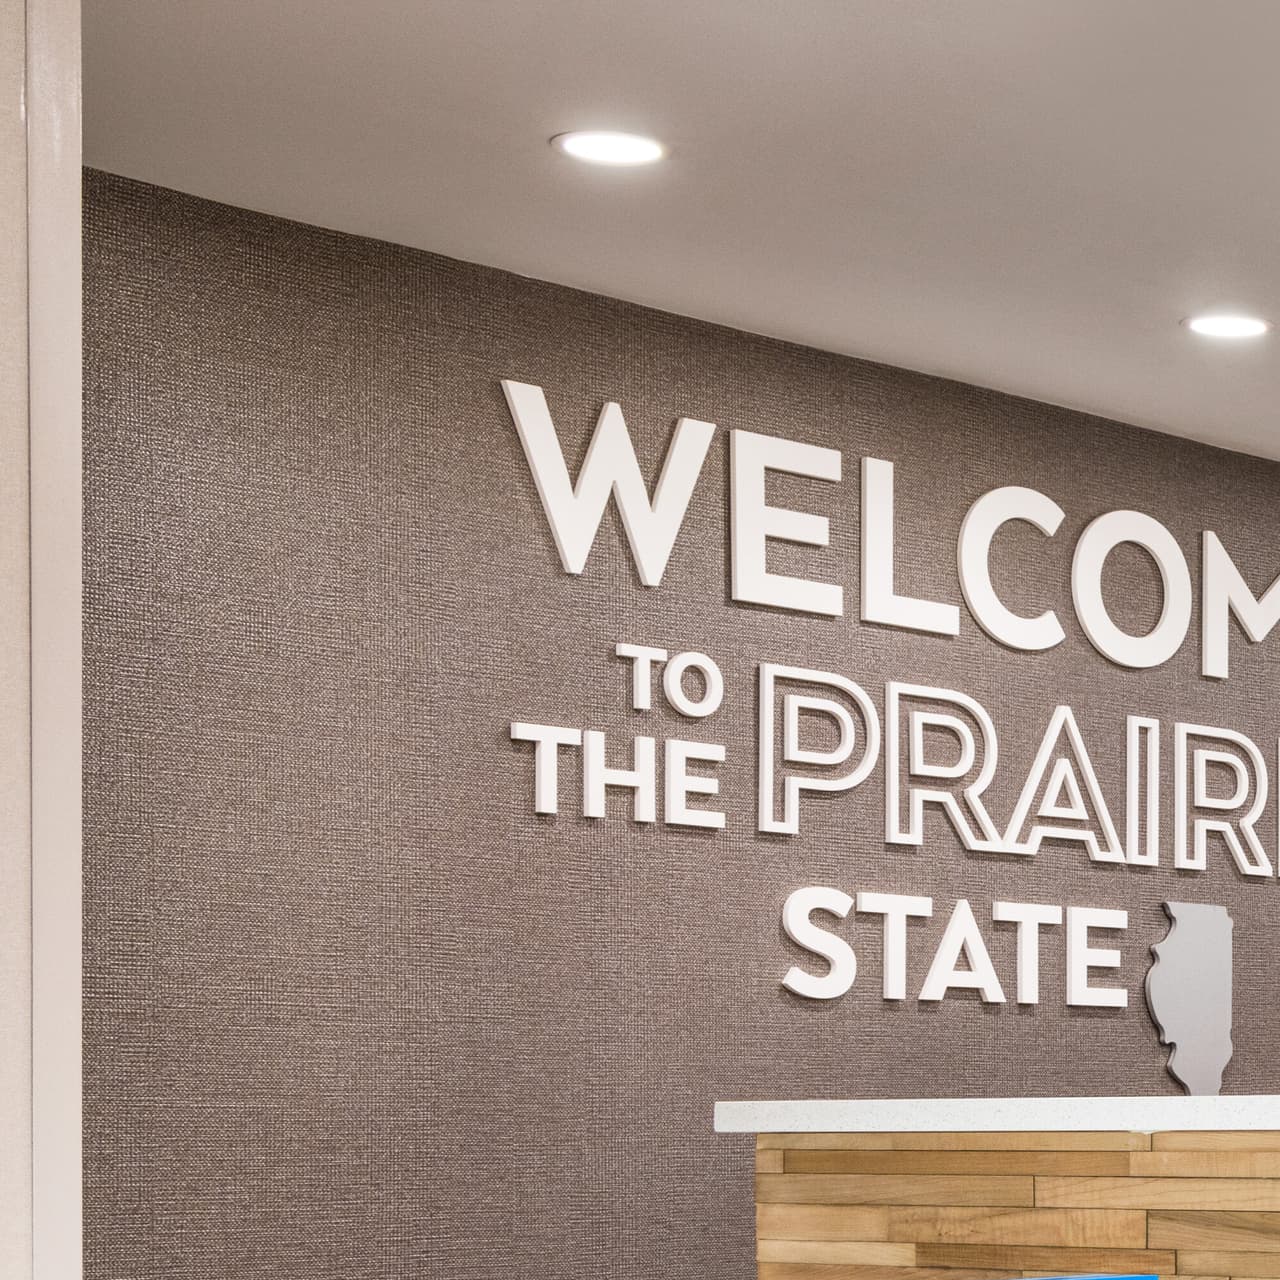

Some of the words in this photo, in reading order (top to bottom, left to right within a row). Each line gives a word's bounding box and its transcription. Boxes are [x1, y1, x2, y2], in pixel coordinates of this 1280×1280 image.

[616, 643, 725, 717] TO
[511, 722, 727, 829] THE
[781, 887, 1129, 1007] STATE
